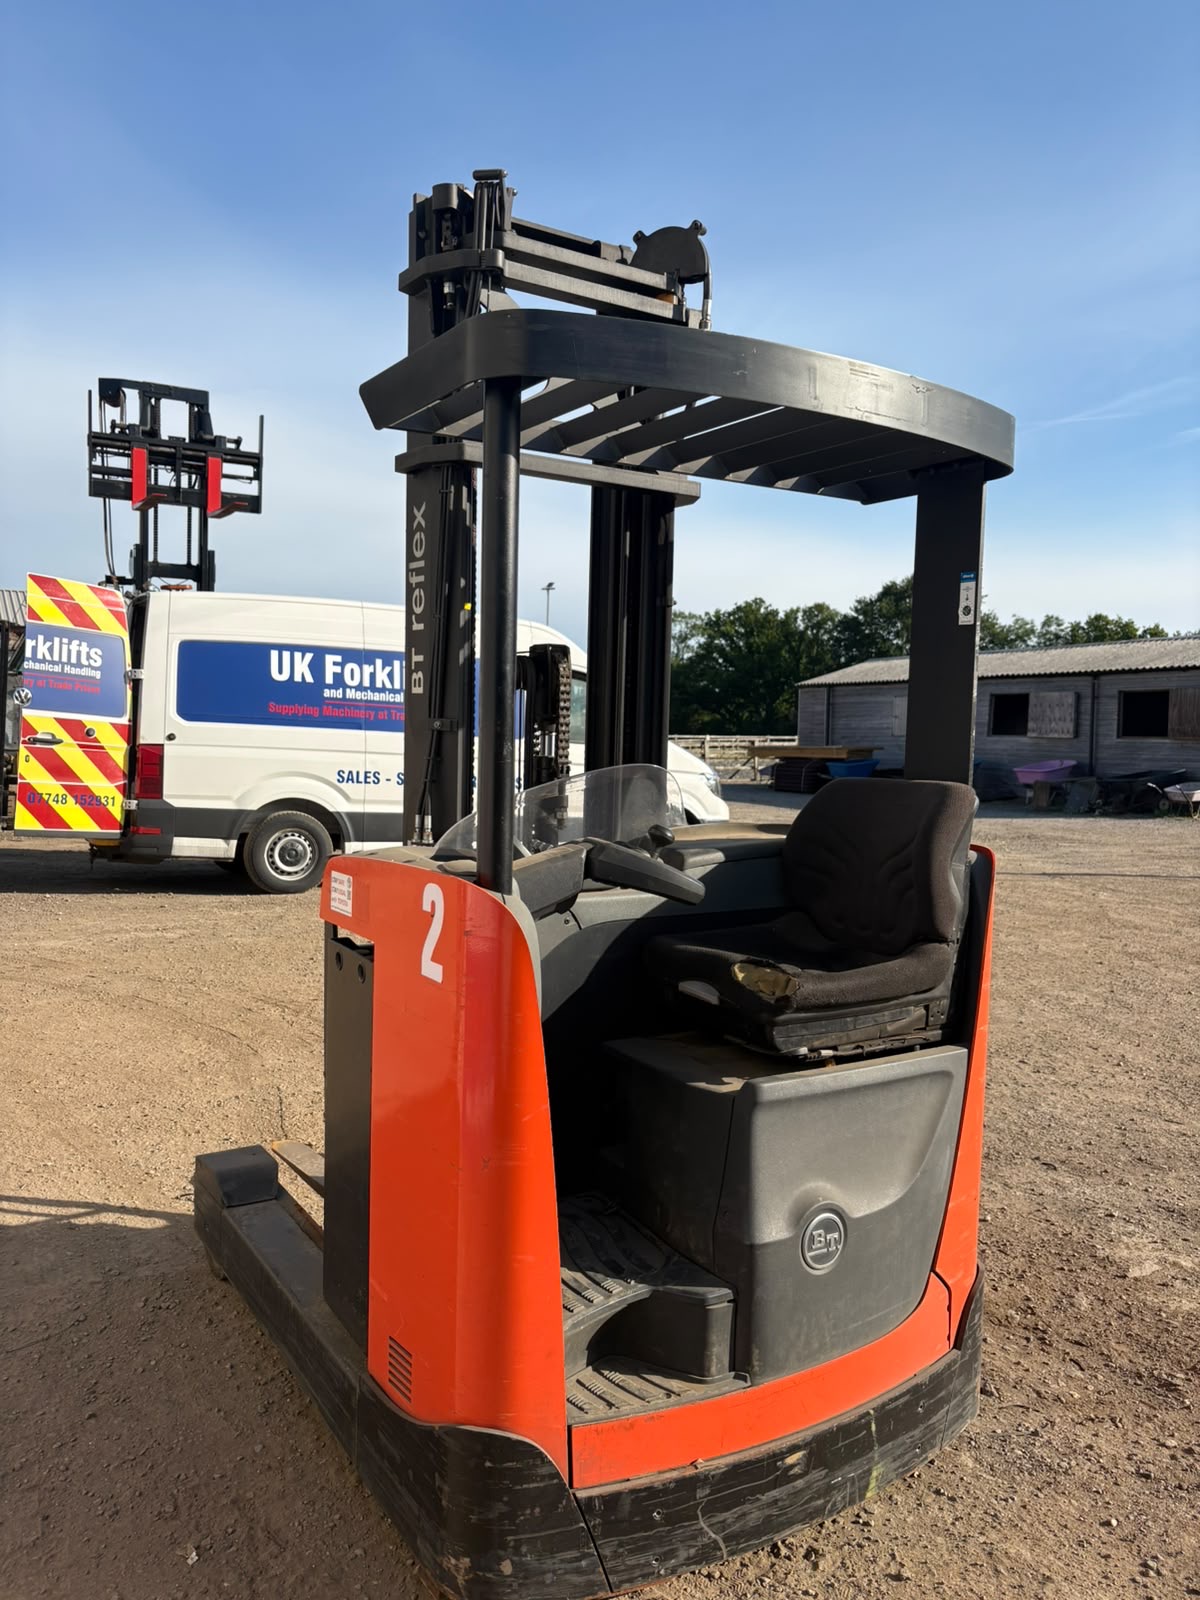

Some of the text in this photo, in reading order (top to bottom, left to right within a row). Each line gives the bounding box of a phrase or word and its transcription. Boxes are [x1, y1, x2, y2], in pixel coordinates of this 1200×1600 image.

[408, 502, 426, 694] BT reflex
[25, 634, 102, 667] rklifts
[64, 664, 101, 679] Handling
[270, 649, 314, 683] UK
[323, 687, 404, 702] and Mechanical
[268, 702, 319, 717] Supplying
[322, 705, 375, 721] Machinery
[336, 769, 381, 785] SALES
[27, 792, 116, 807] 07748 152931
[421, 882, 445, 984] 2
[812, 1229, 839, 1250] BT
